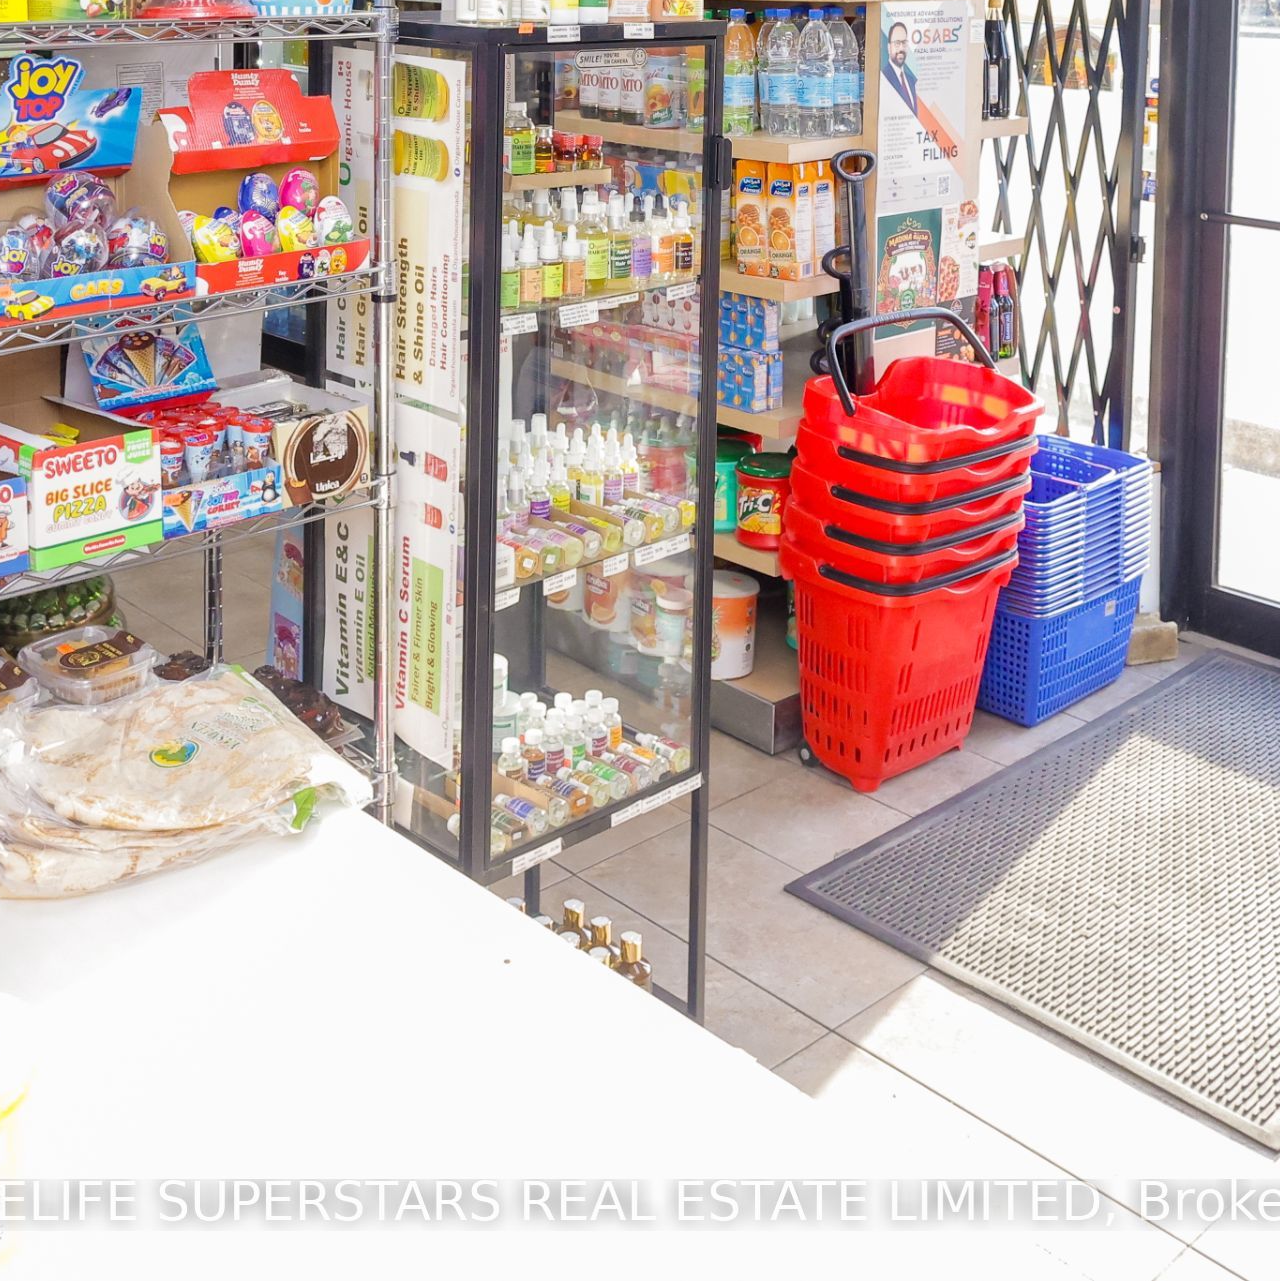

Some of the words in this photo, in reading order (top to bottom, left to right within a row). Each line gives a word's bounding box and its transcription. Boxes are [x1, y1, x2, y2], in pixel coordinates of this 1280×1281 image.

[911, 25, 962, 45] OSABS
[579, 55, 603, 64] SMILE!
[11, 61, 76, 99] JOY
[342, 60, 352, 108] House
[17, 98, 62, 120] TOP
[339, 112, 352, 186] Organic
[916, 130, 938, 145] TAX
[923, 145, 959, 162] FILING
[359, 206, 368, 233] Oil
[740, 248, 761, 256] ORANGE
[71, 279, 123, 300] CARS
[396, 237, 408, 327] Strength
[415, 265, 425, 293] Oil
[441, 254, 450, 337] Conditioning
[336, 325, 345, 360] Hair
[355, 332, 365, 366] Hair
[414, 303, 424, 366] Shine
[429, 305, 437, 367] Damaged
[396, 332, 407, 381] Hair
[440, 340, 448, 370] Hair
[413, 371, 423, 385] &
[45, 447, 117, 479] SWEETO
[45, 488, 69, 506] BIG
[73, 477, 112, 500] SLICE
[315, 481, 340, 492] Unica
[53, 495, 107, 524] PIZZA
[738, 494, 773, 519] Tri-C
[335, 521, 349, 584] E&C
[355, 553, 365, 583] Oil
[399, 535, 411, 603] Serum
[355, 589, 364, 603] E
[415, 577, 423, 603] Skin
[399, 610, 409, 624] C
[413, 607, 422, 651] Firmer
[428, 601, 438, 656] Glowing
[335, 594, 349, 696] Vitamin
[354, 609, 365, 685] Vitamin
[395, 630, 408, 710] Vitamin
[411, 661, 420, 703] Fairer
[425, 669, 436, 710] Bright
